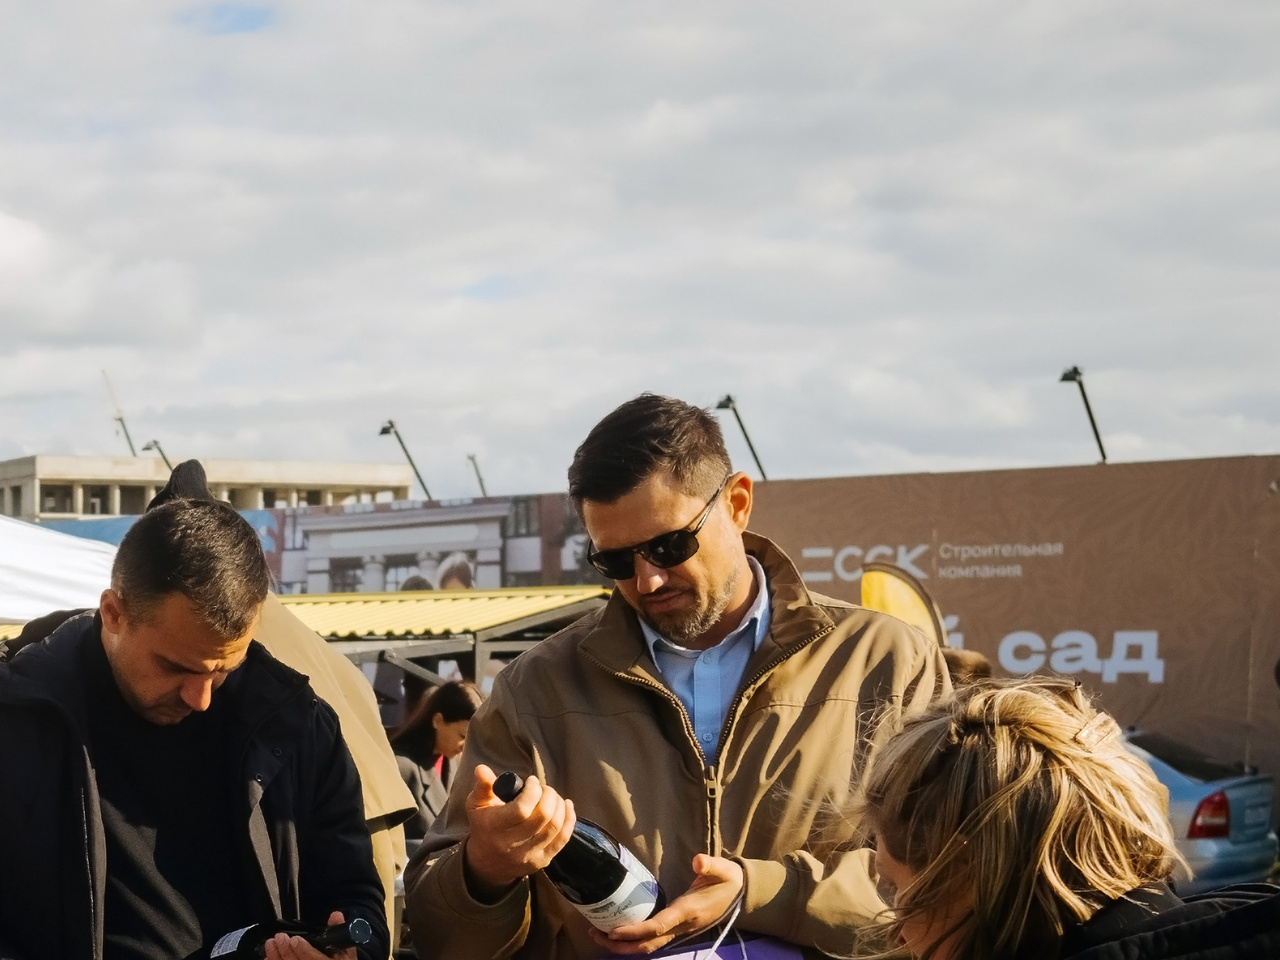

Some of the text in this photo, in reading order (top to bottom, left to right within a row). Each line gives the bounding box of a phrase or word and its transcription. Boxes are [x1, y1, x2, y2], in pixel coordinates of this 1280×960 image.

[939, 542, 1064, 562] Строительная
[938, 564, 1022, 579] компания
[997, 630, 1165, 684] сад
